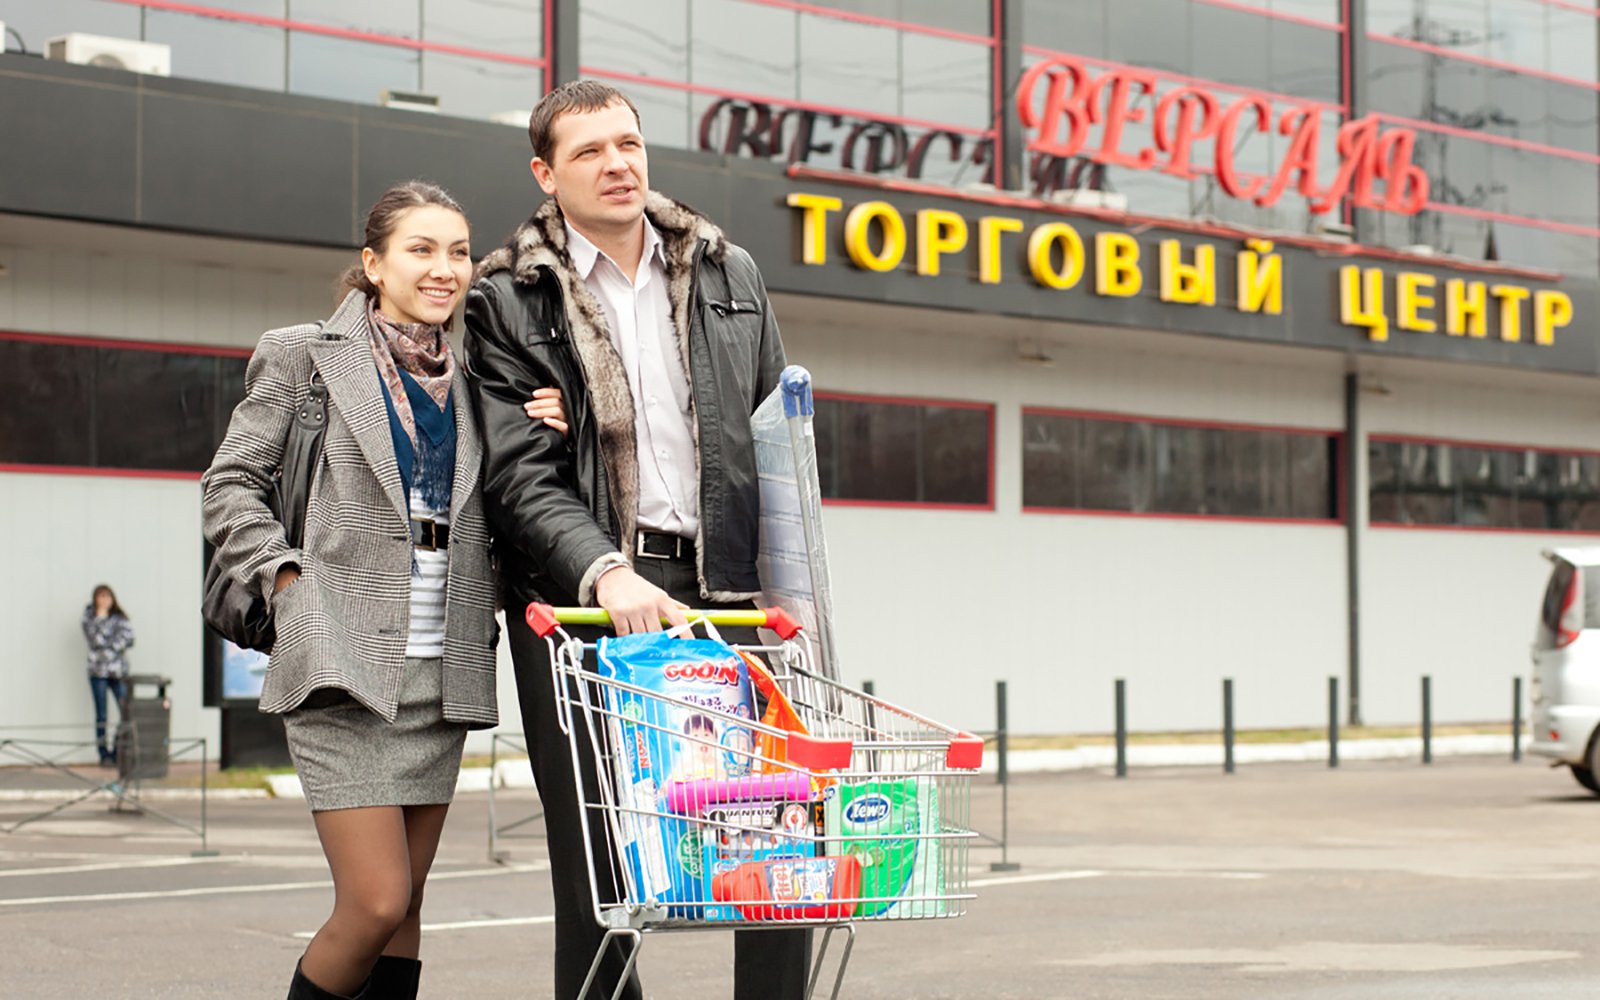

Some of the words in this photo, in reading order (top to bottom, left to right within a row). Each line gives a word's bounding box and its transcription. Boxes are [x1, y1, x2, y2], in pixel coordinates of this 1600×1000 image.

[1016, 58, 1429, 215] ВЕРСАЛЬ
[787, 193, 1283, 315] ТОРГОВЫЙ
[1339, 265, 1573, 345] ЦЕНТР
[850, 802, 886, 818] Zewa
